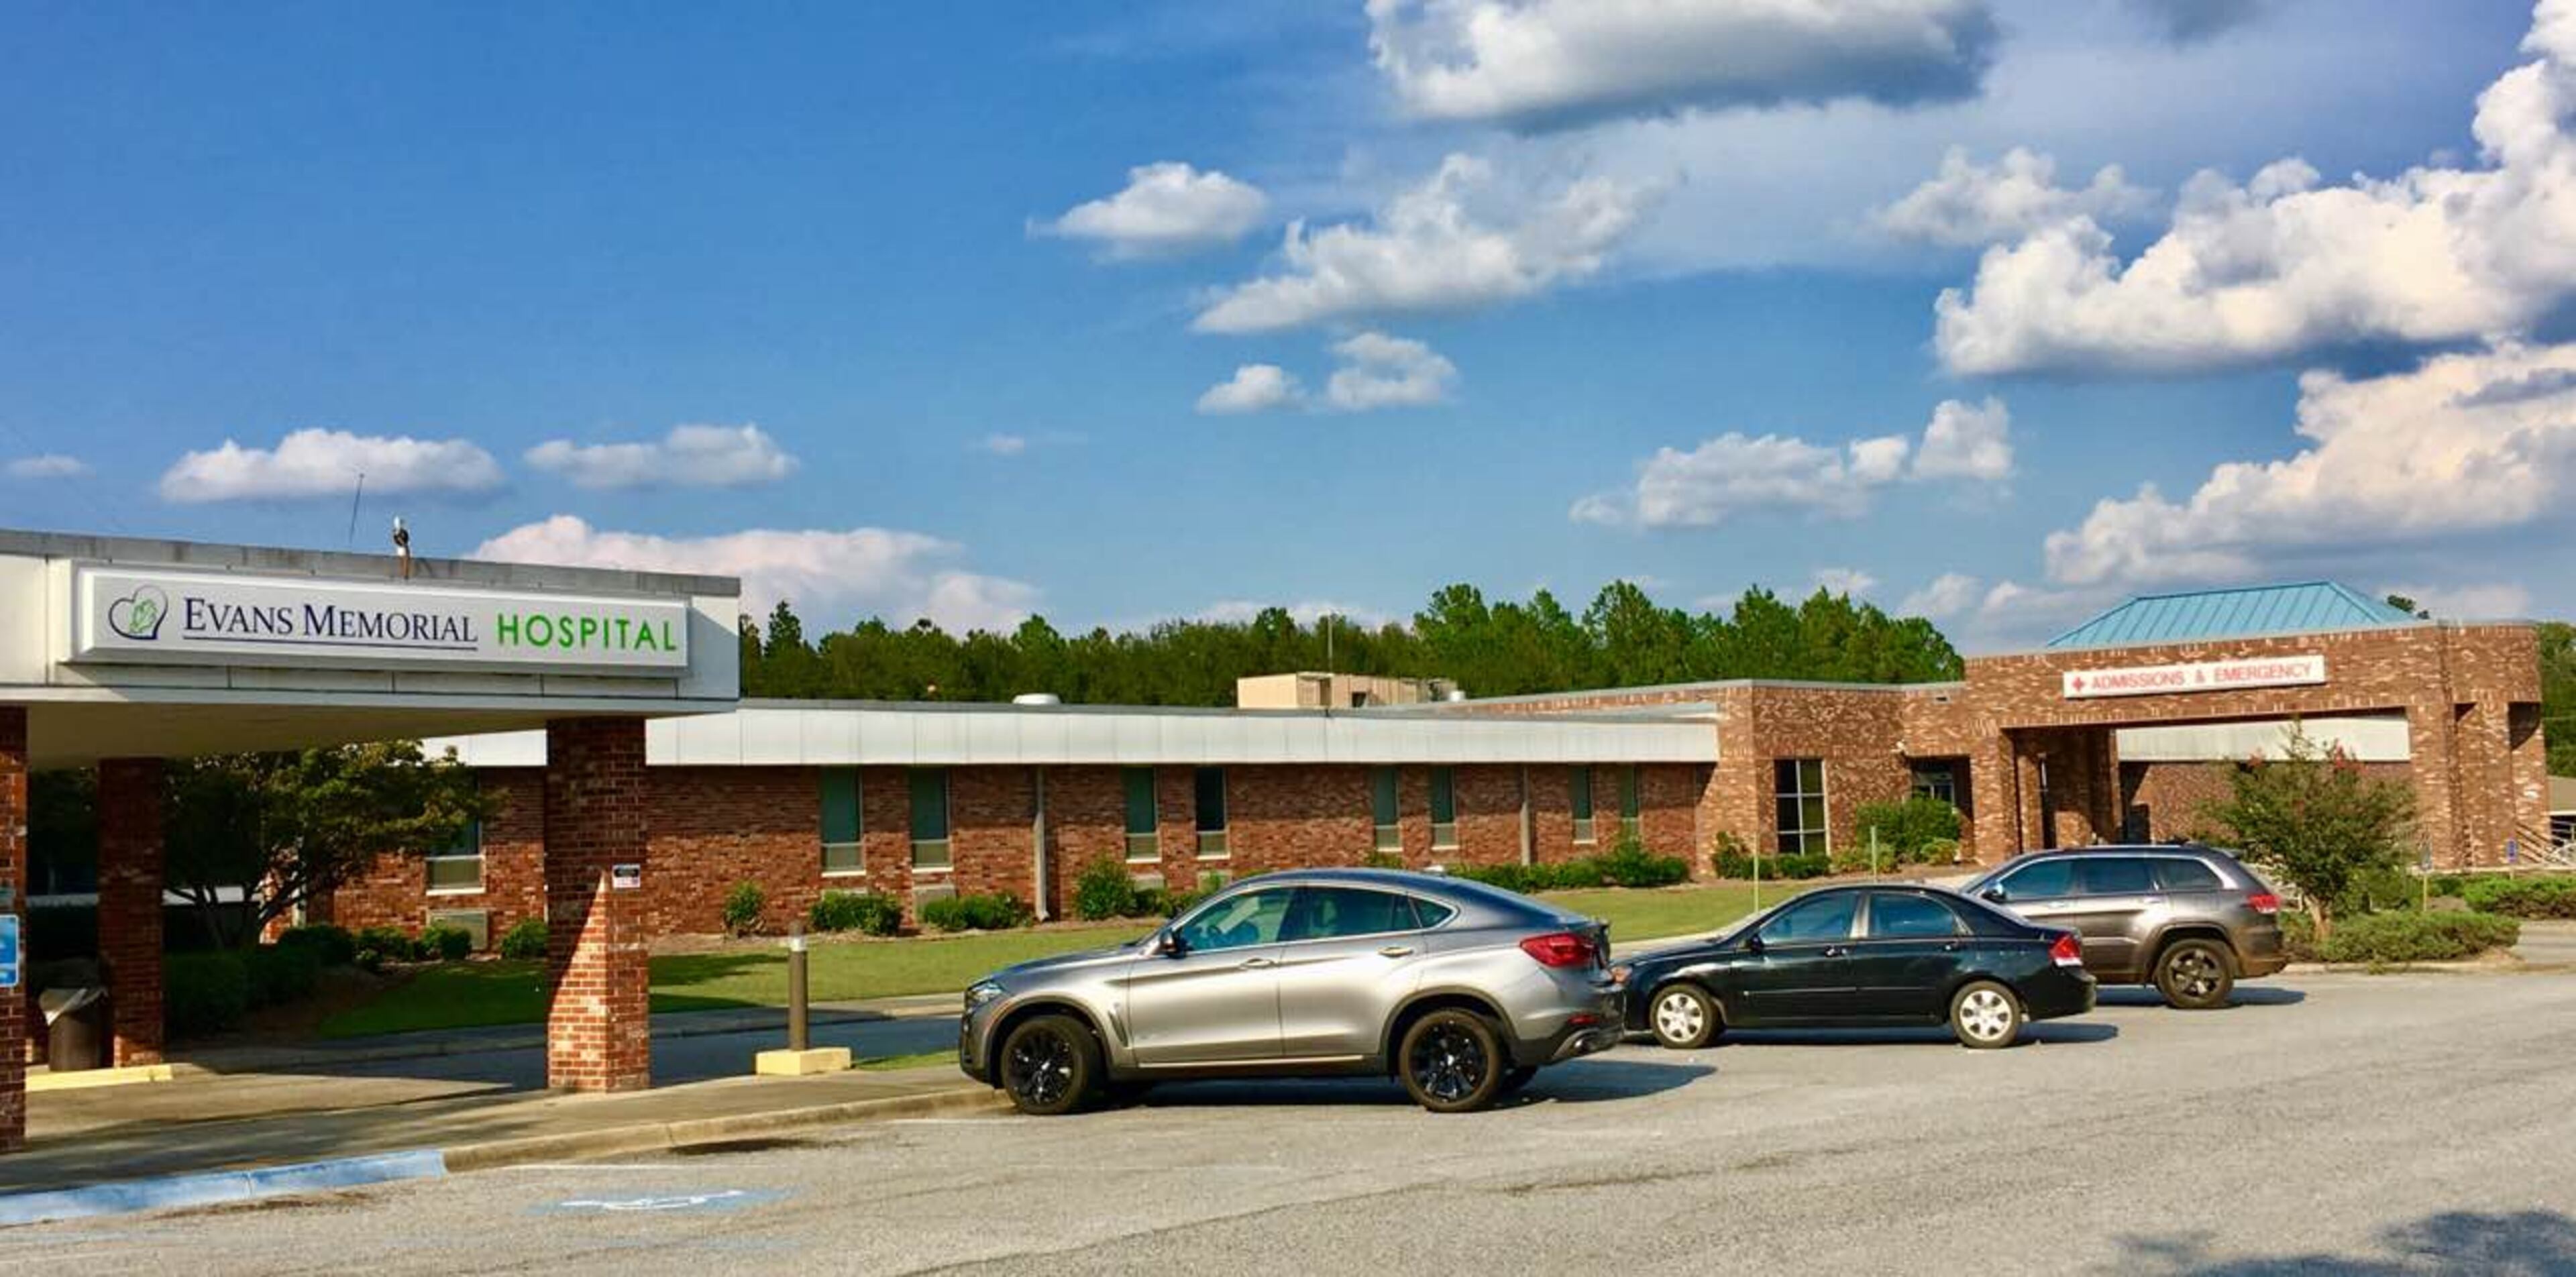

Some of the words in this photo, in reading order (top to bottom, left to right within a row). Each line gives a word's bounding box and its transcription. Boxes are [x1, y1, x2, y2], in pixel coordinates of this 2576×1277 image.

[184, 597, 293, 636] EVANS
[303, 604, 478, 642] MEMORIAL
[497, 614, 677, 651] HOSPITAL
[2092, 671, 2185, 689] ADMISSIONS
[2195, 669, 2206, 683] &
[2214, 662, 2312, 682] EMERGENCY
